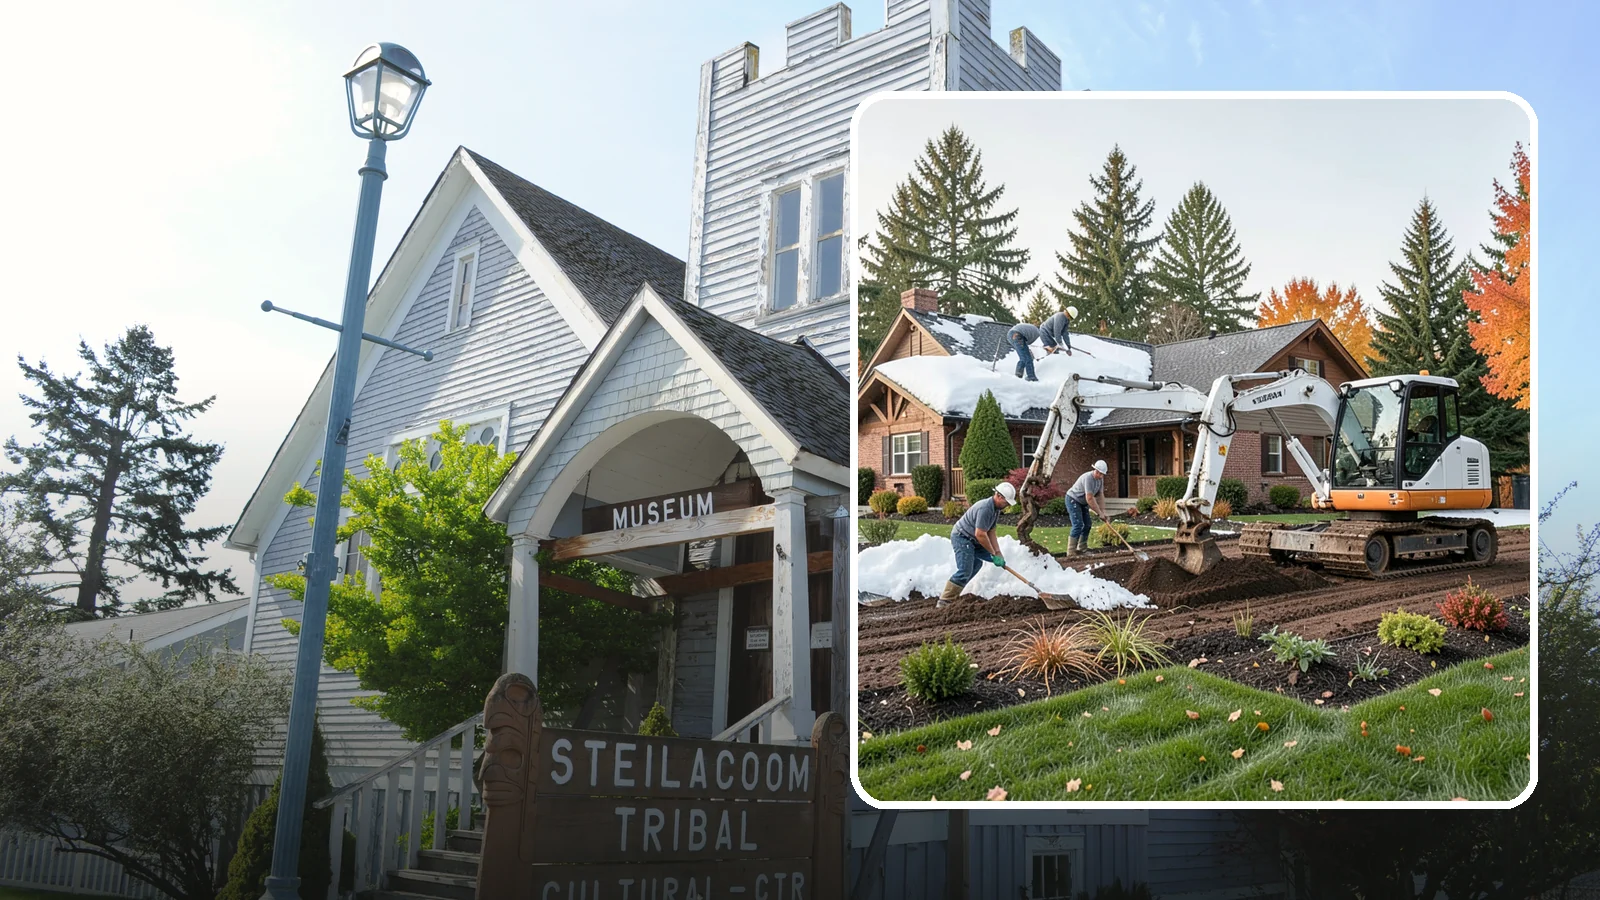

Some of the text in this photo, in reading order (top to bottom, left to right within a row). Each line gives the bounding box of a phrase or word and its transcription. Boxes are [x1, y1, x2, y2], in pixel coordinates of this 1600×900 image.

[613, 491, 713, 530] MUSEUM
[550, 738, 809, 792] STEILACOOM
[614, 806, 758, 851] TRIBAL
